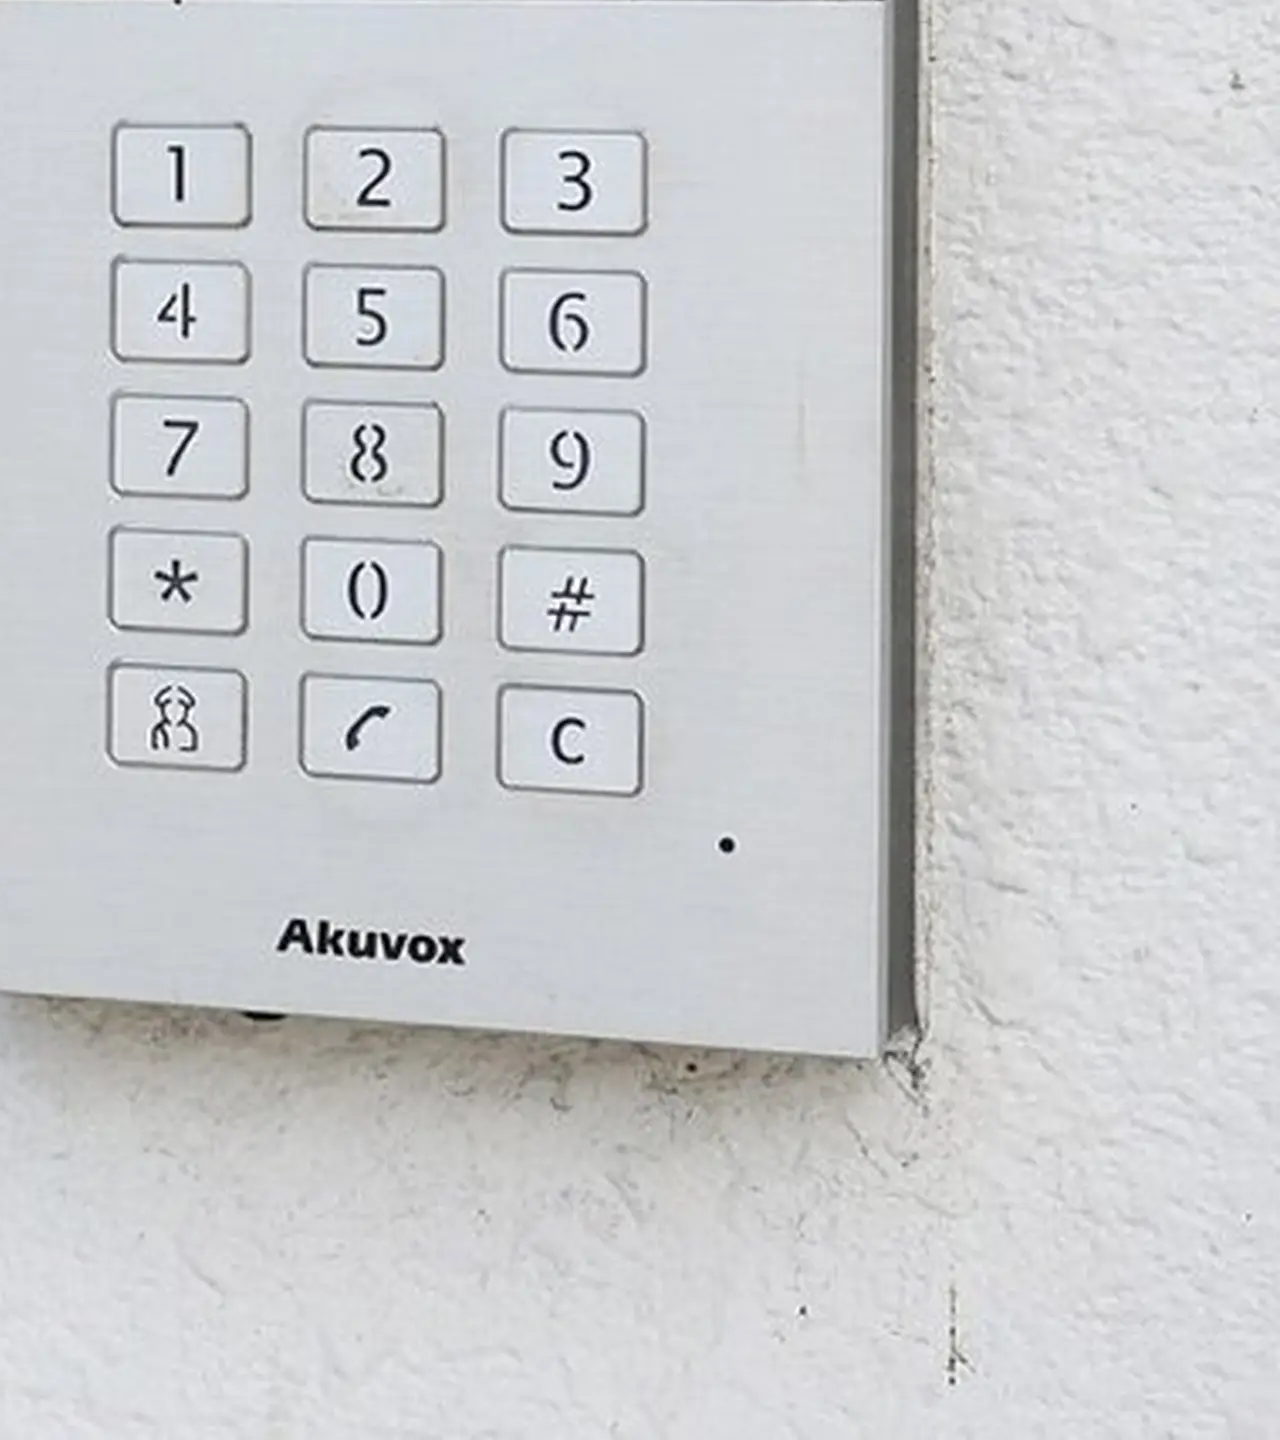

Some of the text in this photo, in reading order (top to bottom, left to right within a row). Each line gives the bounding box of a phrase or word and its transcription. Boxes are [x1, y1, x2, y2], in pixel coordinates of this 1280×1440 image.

[166, 144, 594, 212] 1 2 3
[156, 282, 590, 353] 4 5 6
[161, 418, 591, 491] 7 8 9
[347, 560, 389, 621] 0
[546, 575, 596, 633] #
[550, 716, 587, 766] C
[275, 917, 467, 967] Akuvox
